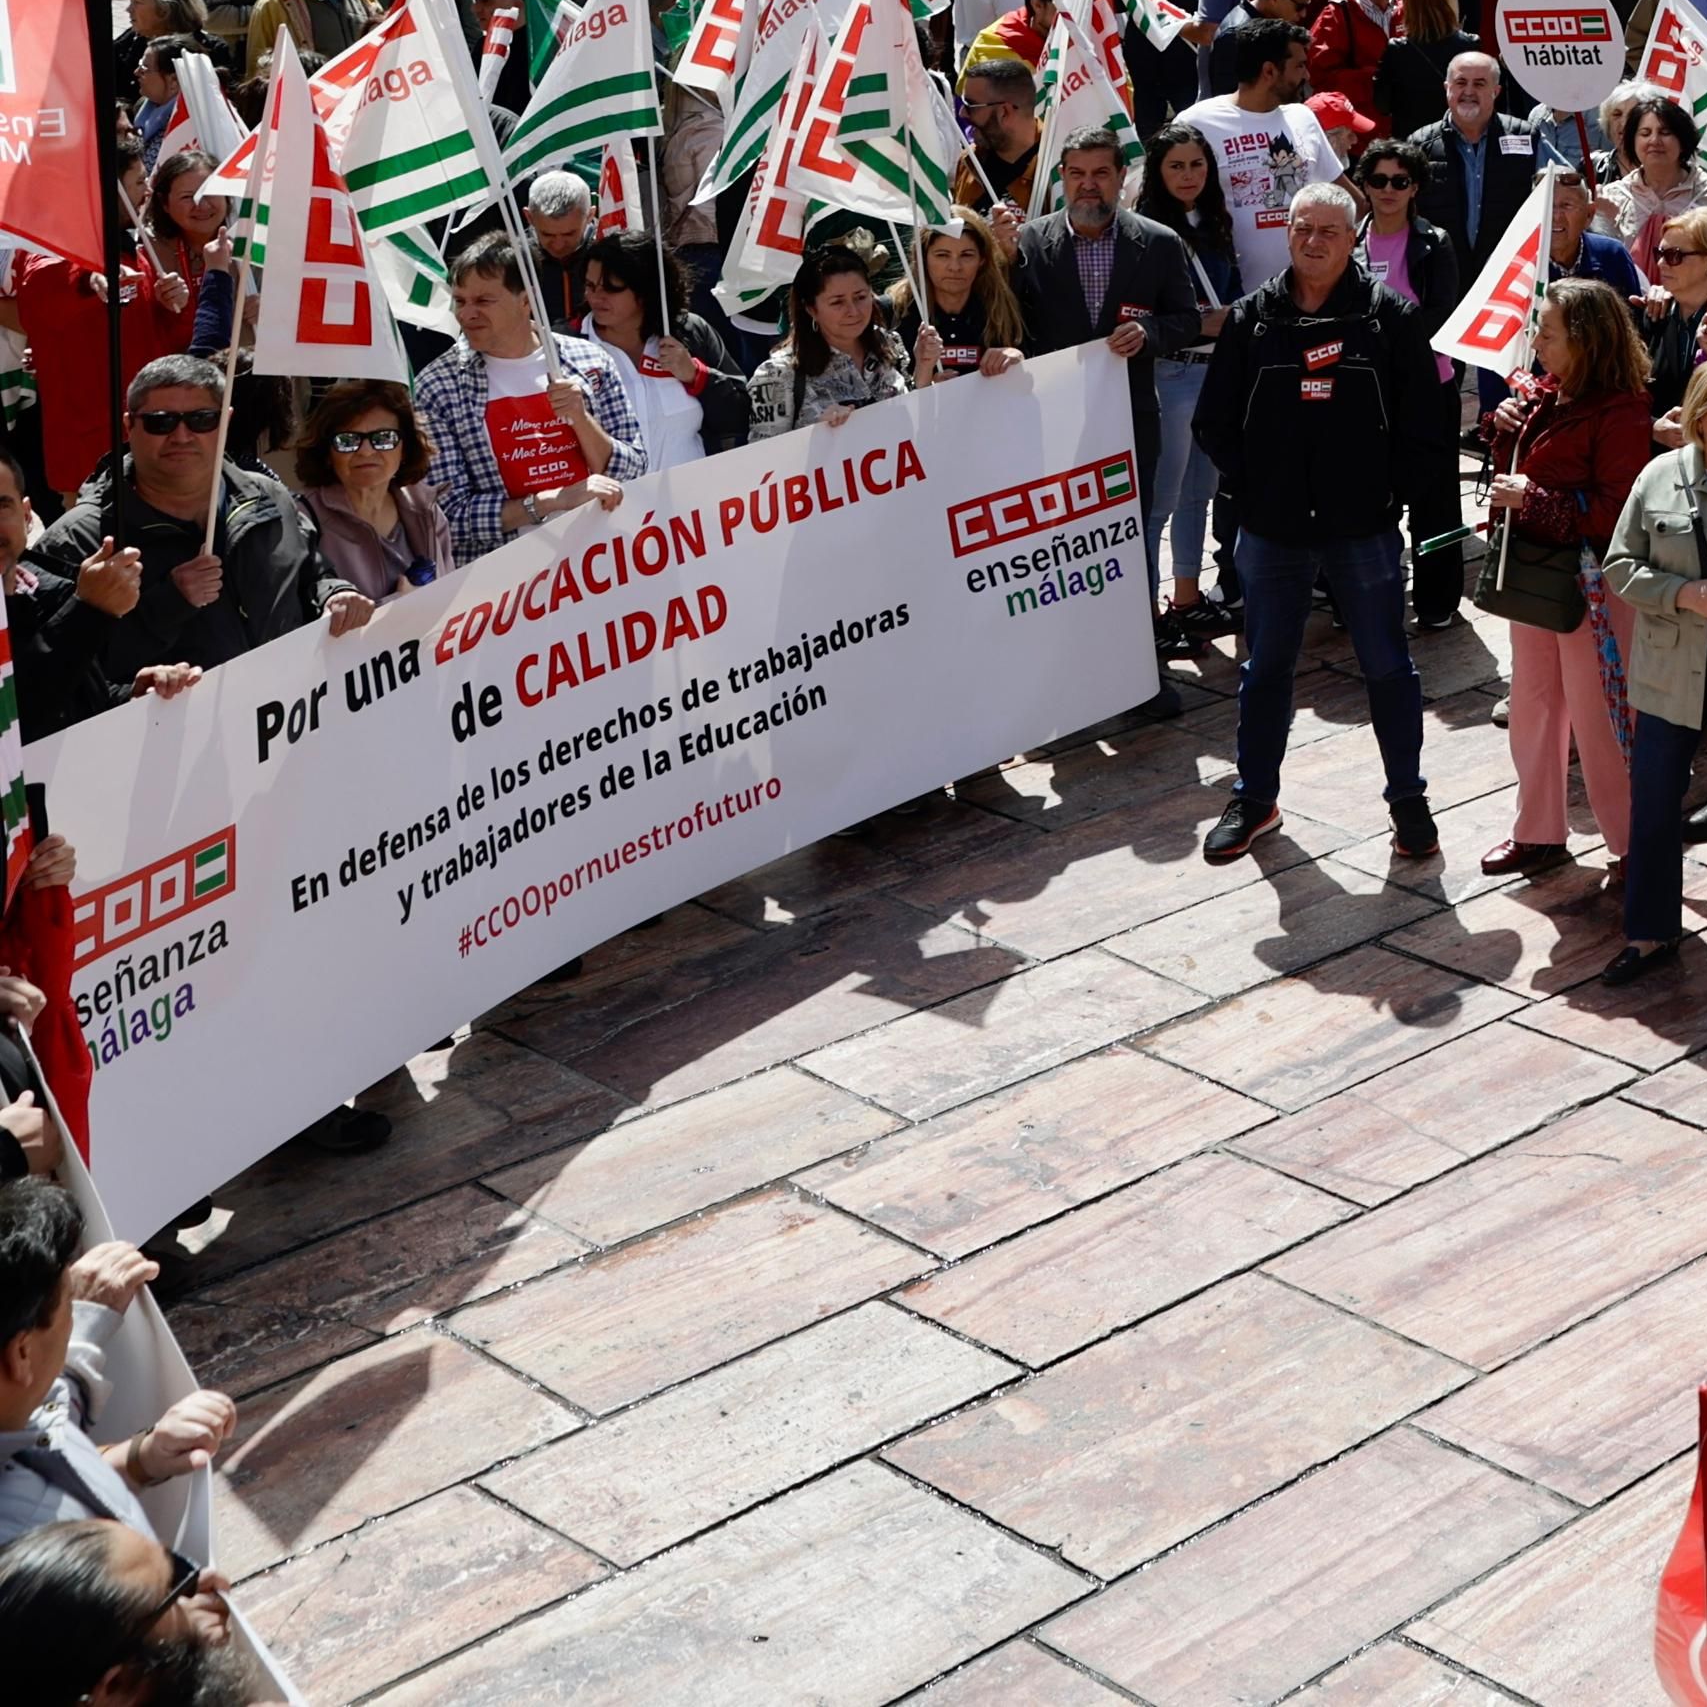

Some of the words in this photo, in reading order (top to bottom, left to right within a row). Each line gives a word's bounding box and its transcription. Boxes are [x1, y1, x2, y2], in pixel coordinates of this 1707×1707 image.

[1523, 44, 1604, 67] hábitat
[528, 460, 569, 477] CCOO
[954, 468, 1100, 545] CCOO
[256, 678, 328, 763] Por
[344, 638, 421, 713] una
[434, 509, 706, 666] EDUCACIÓN
[719, 440, 926, 547] PÚBLICA
[966, 514, 1141, 594] enseñanza
[1006, 555, 1124, 618] málaga
[450, 682, 503, 743] de
[515, 583, 728, 709] CALIDAD
[291, 872, 328, 913] En
[338, 807, 451, 890] defensa
[457, 783, 485, 821] de
[491, 757, 531, 800] los
[538, 697, 674, 778] derechos
[680, 672, 721, 711] de
[728, 599, 911, 700] trabajadoras
[397, 884, 414, 925] y
[420, 784, 592, 904] trabajadores
[598, 763, 635, 800] de
[642, 741, 672, 781] la
[679, 681, 828, 766] Educación
[457, 774, 783, 955] #CCOOpornuestrofuturo
[74, 918, 229, 1029] señanza
